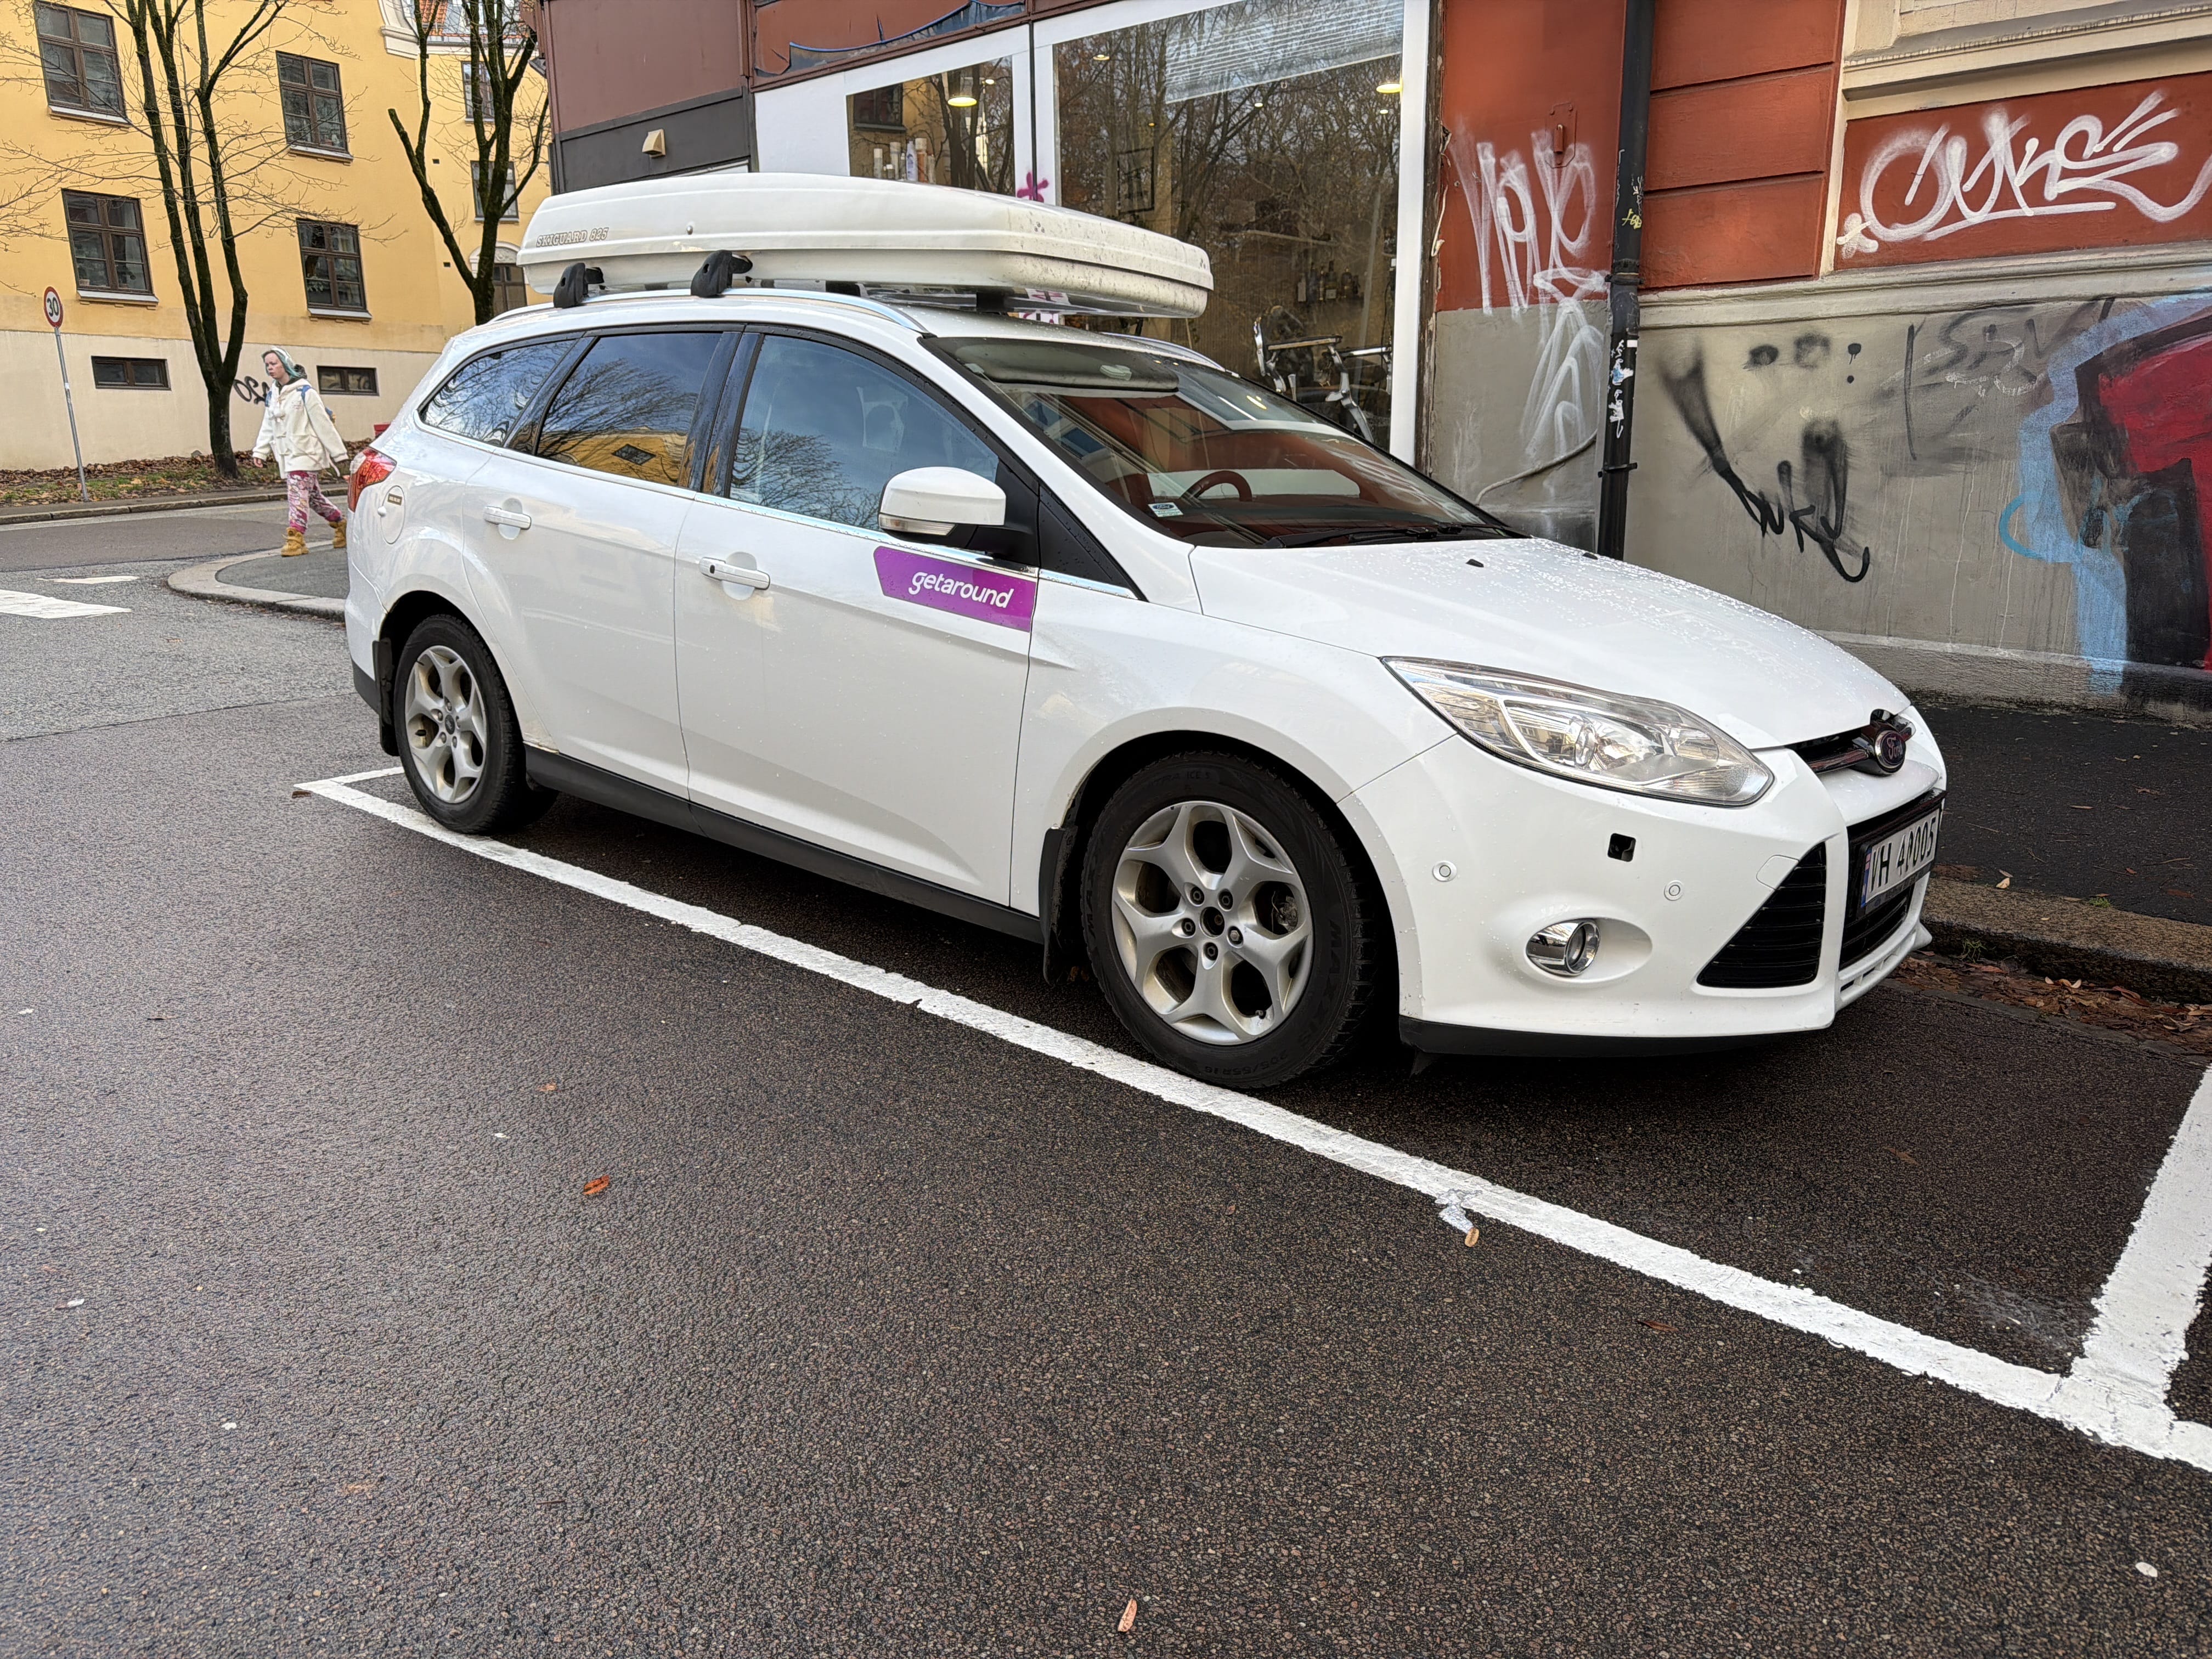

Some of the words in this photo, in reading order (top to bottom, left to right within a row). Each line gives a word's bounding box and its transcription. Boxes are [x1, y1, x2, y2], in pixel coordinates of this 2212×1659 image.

[536, 230, 588, 247] SKIGUARD
[589, 227, 610, 241] 825
[47, 297, 59, 317] 30
[908, 572, 1014, 608] getaround
[1887, 736, 1903, 760] Ford
[1871, 842, 1892, 892] VH
[1896, 816, 1936, 876] 40005
